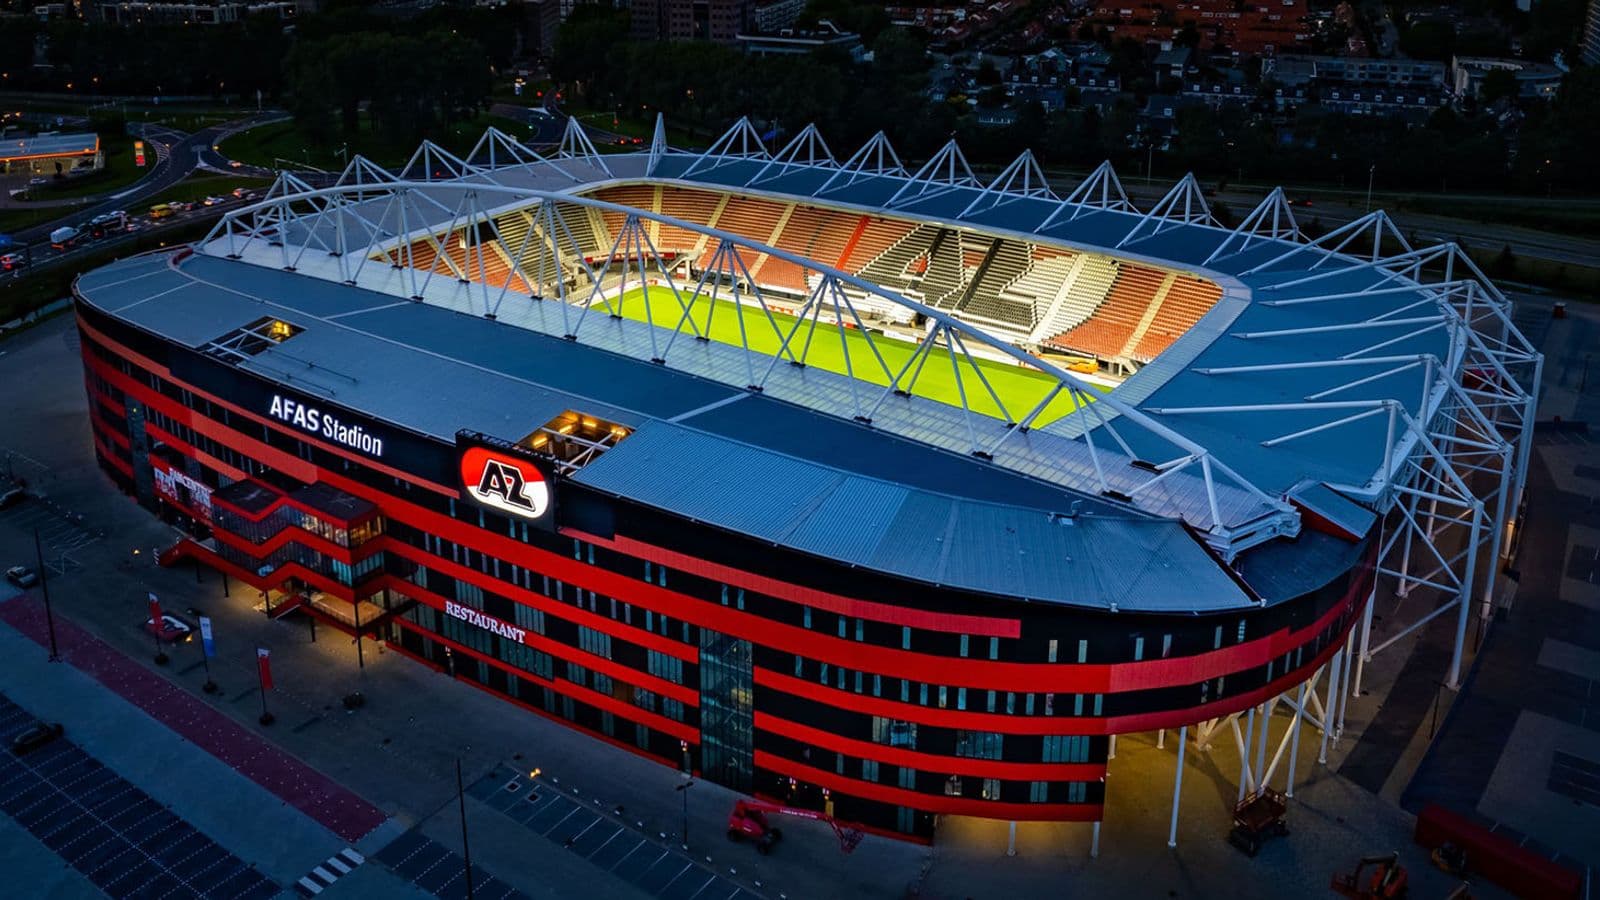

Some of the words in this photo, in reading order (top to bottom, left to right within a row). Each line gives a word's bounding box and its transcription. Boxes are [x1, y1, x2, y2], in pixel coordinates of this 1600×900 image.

[269, 394, 320, 432] AFAS
[322, 414, 382, 457] Stadion
[478, 458, 536, 512] AZ
[445, 600, 526, 644] RESTAURANT
